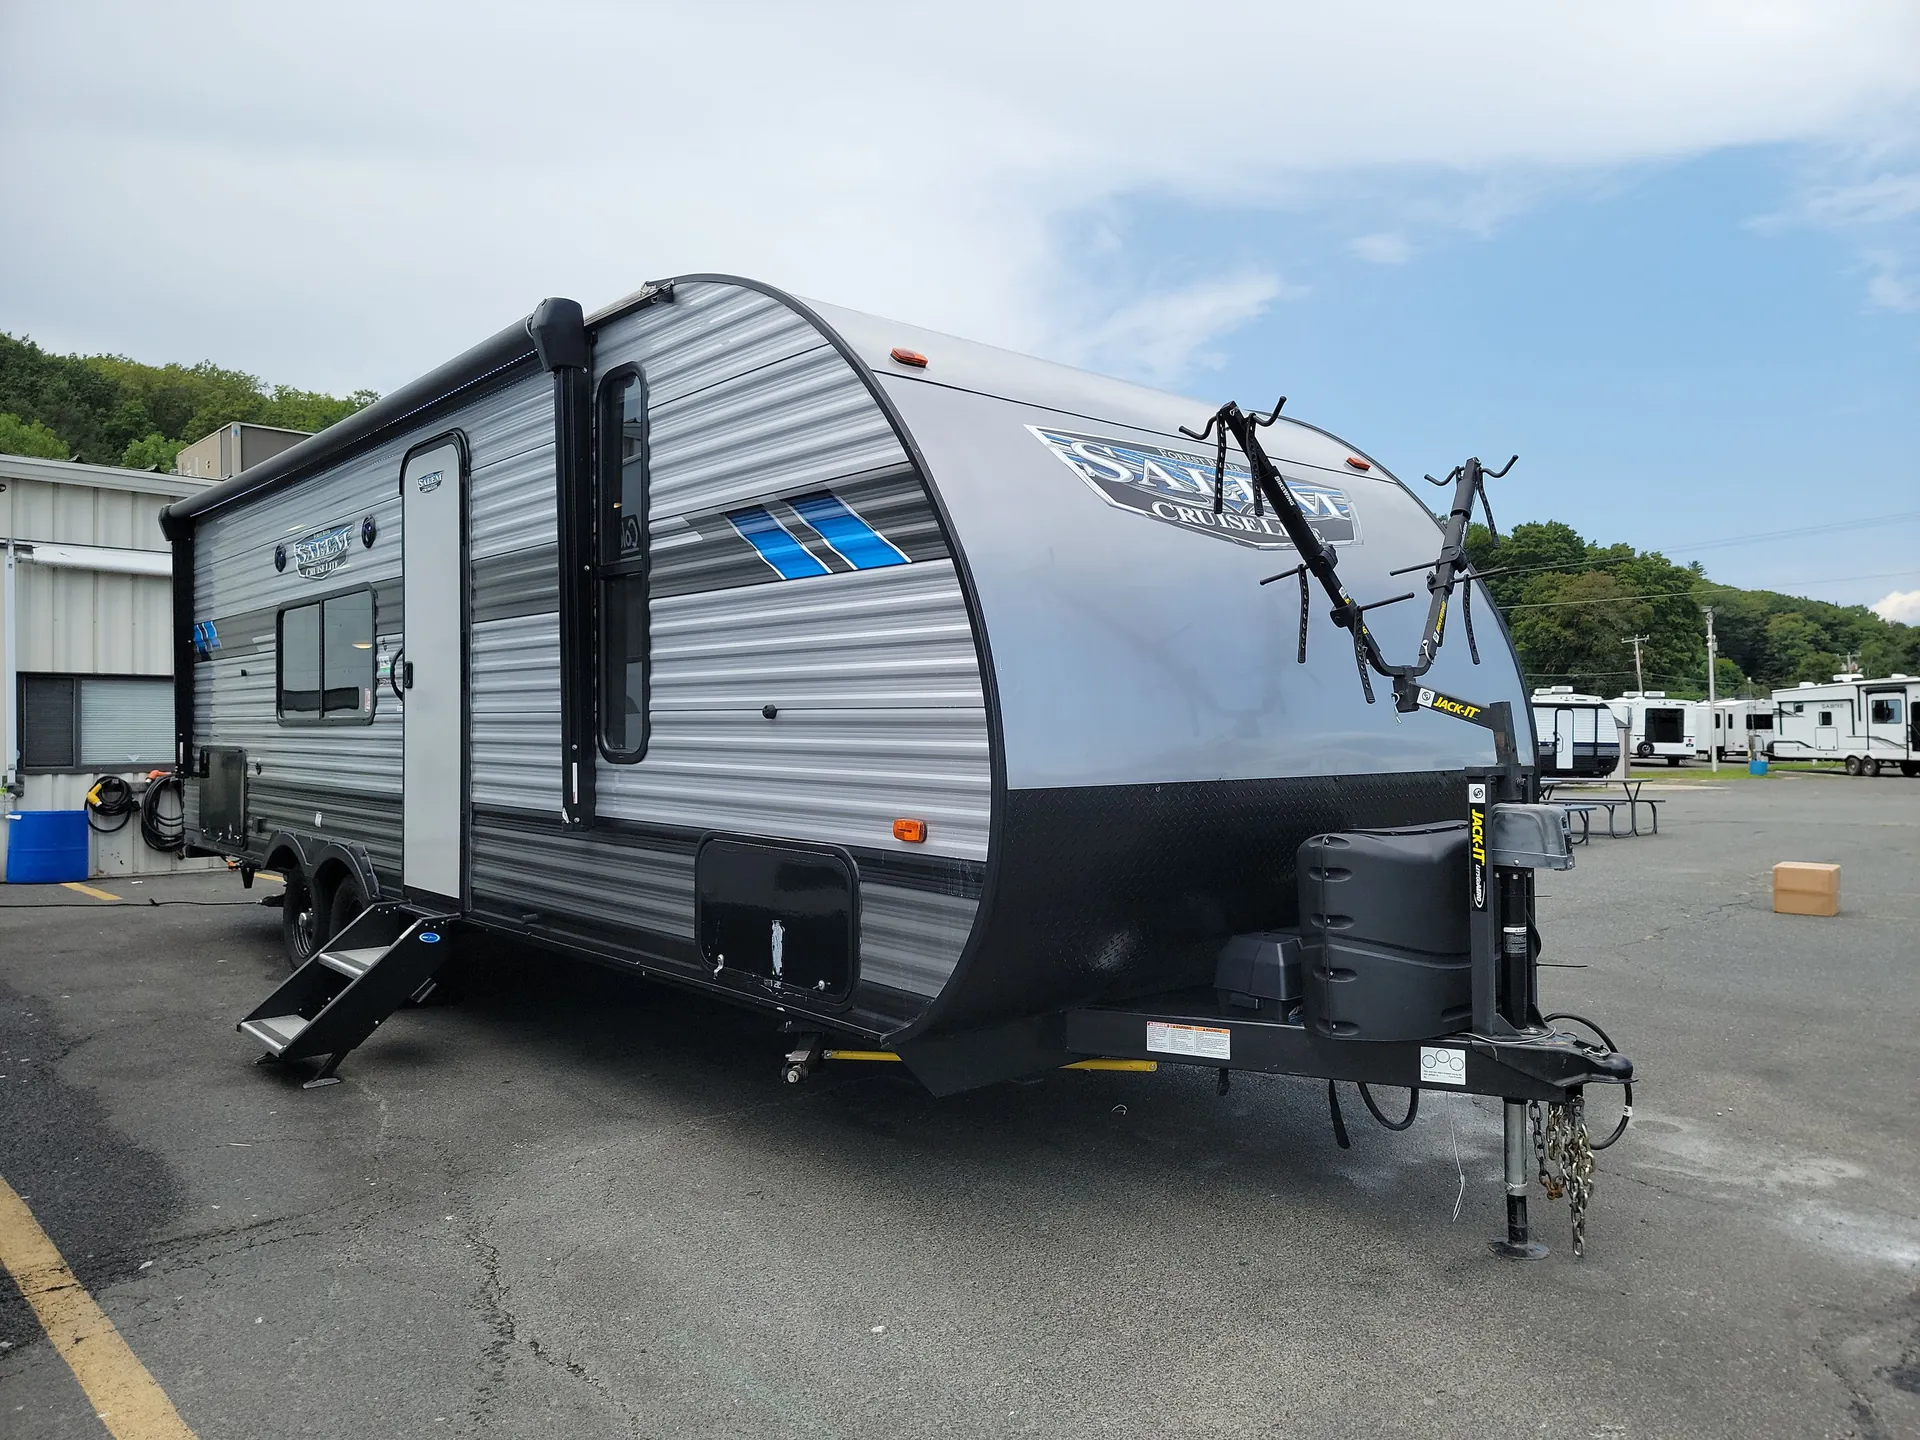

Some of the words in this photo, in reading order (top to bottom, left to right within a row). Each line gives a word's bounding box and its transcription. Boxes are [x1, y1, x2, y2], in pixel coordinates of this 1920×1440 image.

[1158, 448, 1205, 467] FOREST
[1274, 475, 1296, 507] BIKEWING
[1433, 696, 1479, 719] JACK-IT
[1471, 808, 1486, 864] JACK-IT
